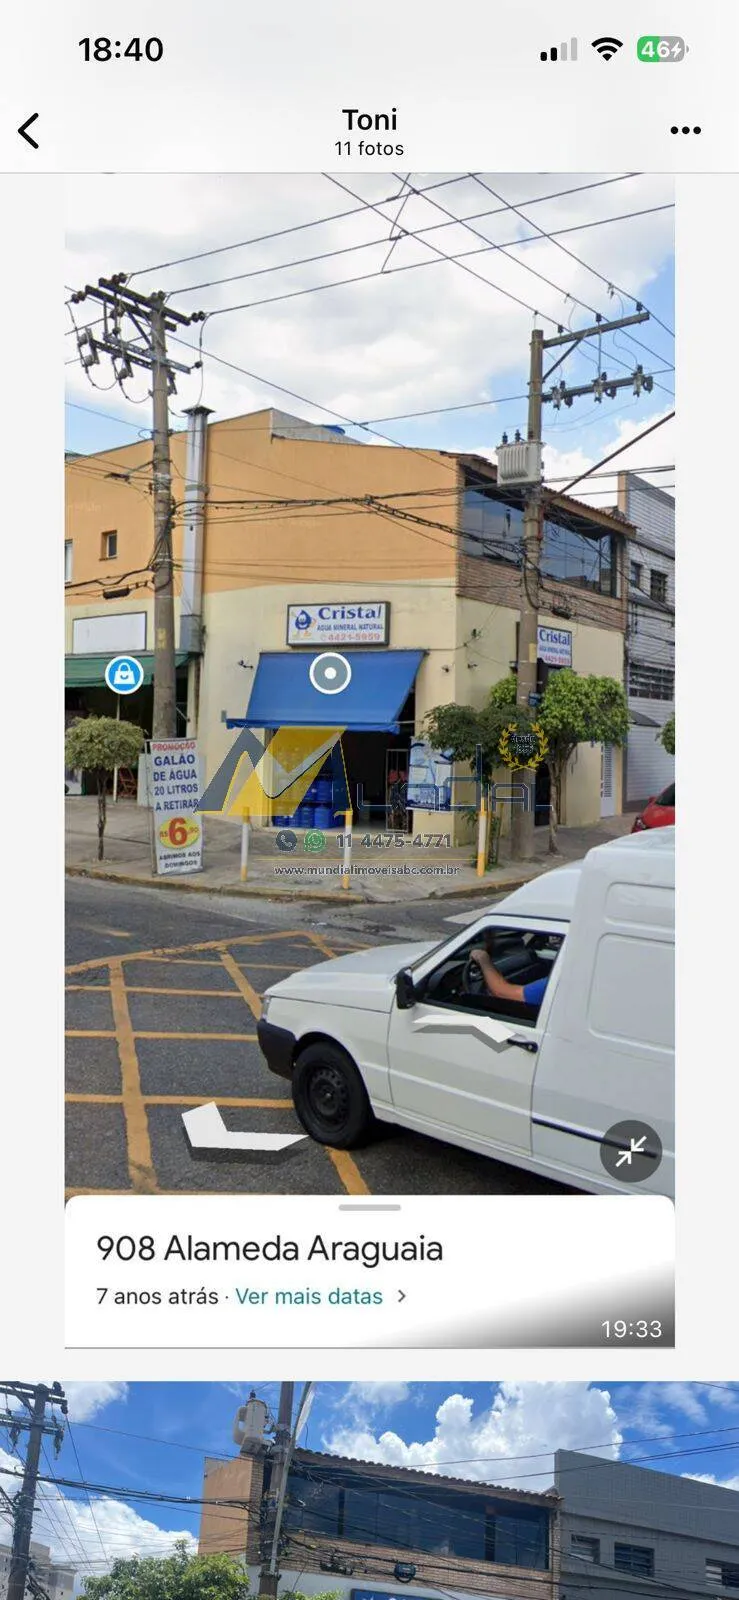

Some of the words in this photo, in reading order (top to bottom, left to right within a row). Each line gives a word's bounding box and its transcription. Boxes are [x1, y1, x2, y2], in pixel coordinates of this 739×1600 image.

[79, 38, 163, 63] 18:40
[642, 41, 670, 59] 46
[342, 108, 398, 132] Toni
[335, 141, 352, 157] 11
[358, 141, 405, 157] fotos
[318, 604, 383, 620] Cristal
[333, 623, 357, 631] MINERAL
[358, 623, 384, 631] NATURAL
[539, 629, 570, 646] Cristal
[153, 771, 166, 782] DE
[154, 786, 165, 796] 20
[167, 784, 198, 795] LITROS
[155, 802, 162, 811] A
[164, 799, 199, 811] RETIRAR
[159, 852, 186, 860] ABRIMOS
[188, 850, 200, 858] AOS
[164, 860, 197, 868] DOMINGOS
[96, 1235, 156, 1262] 908
[164, 1235, 300, 1262] Alameda
[307, 1235, 444, 1268] Araguaia
[97, 1288, 107, 1305] 7
[114, 1291, 163, 1306] anos
[168, 1288, 219, 1306] atrás
[235, 1288, 270, 1306] Ver
[274, 1288, 321, 1306] mais
[328, 1288, 383, 1306] datas
